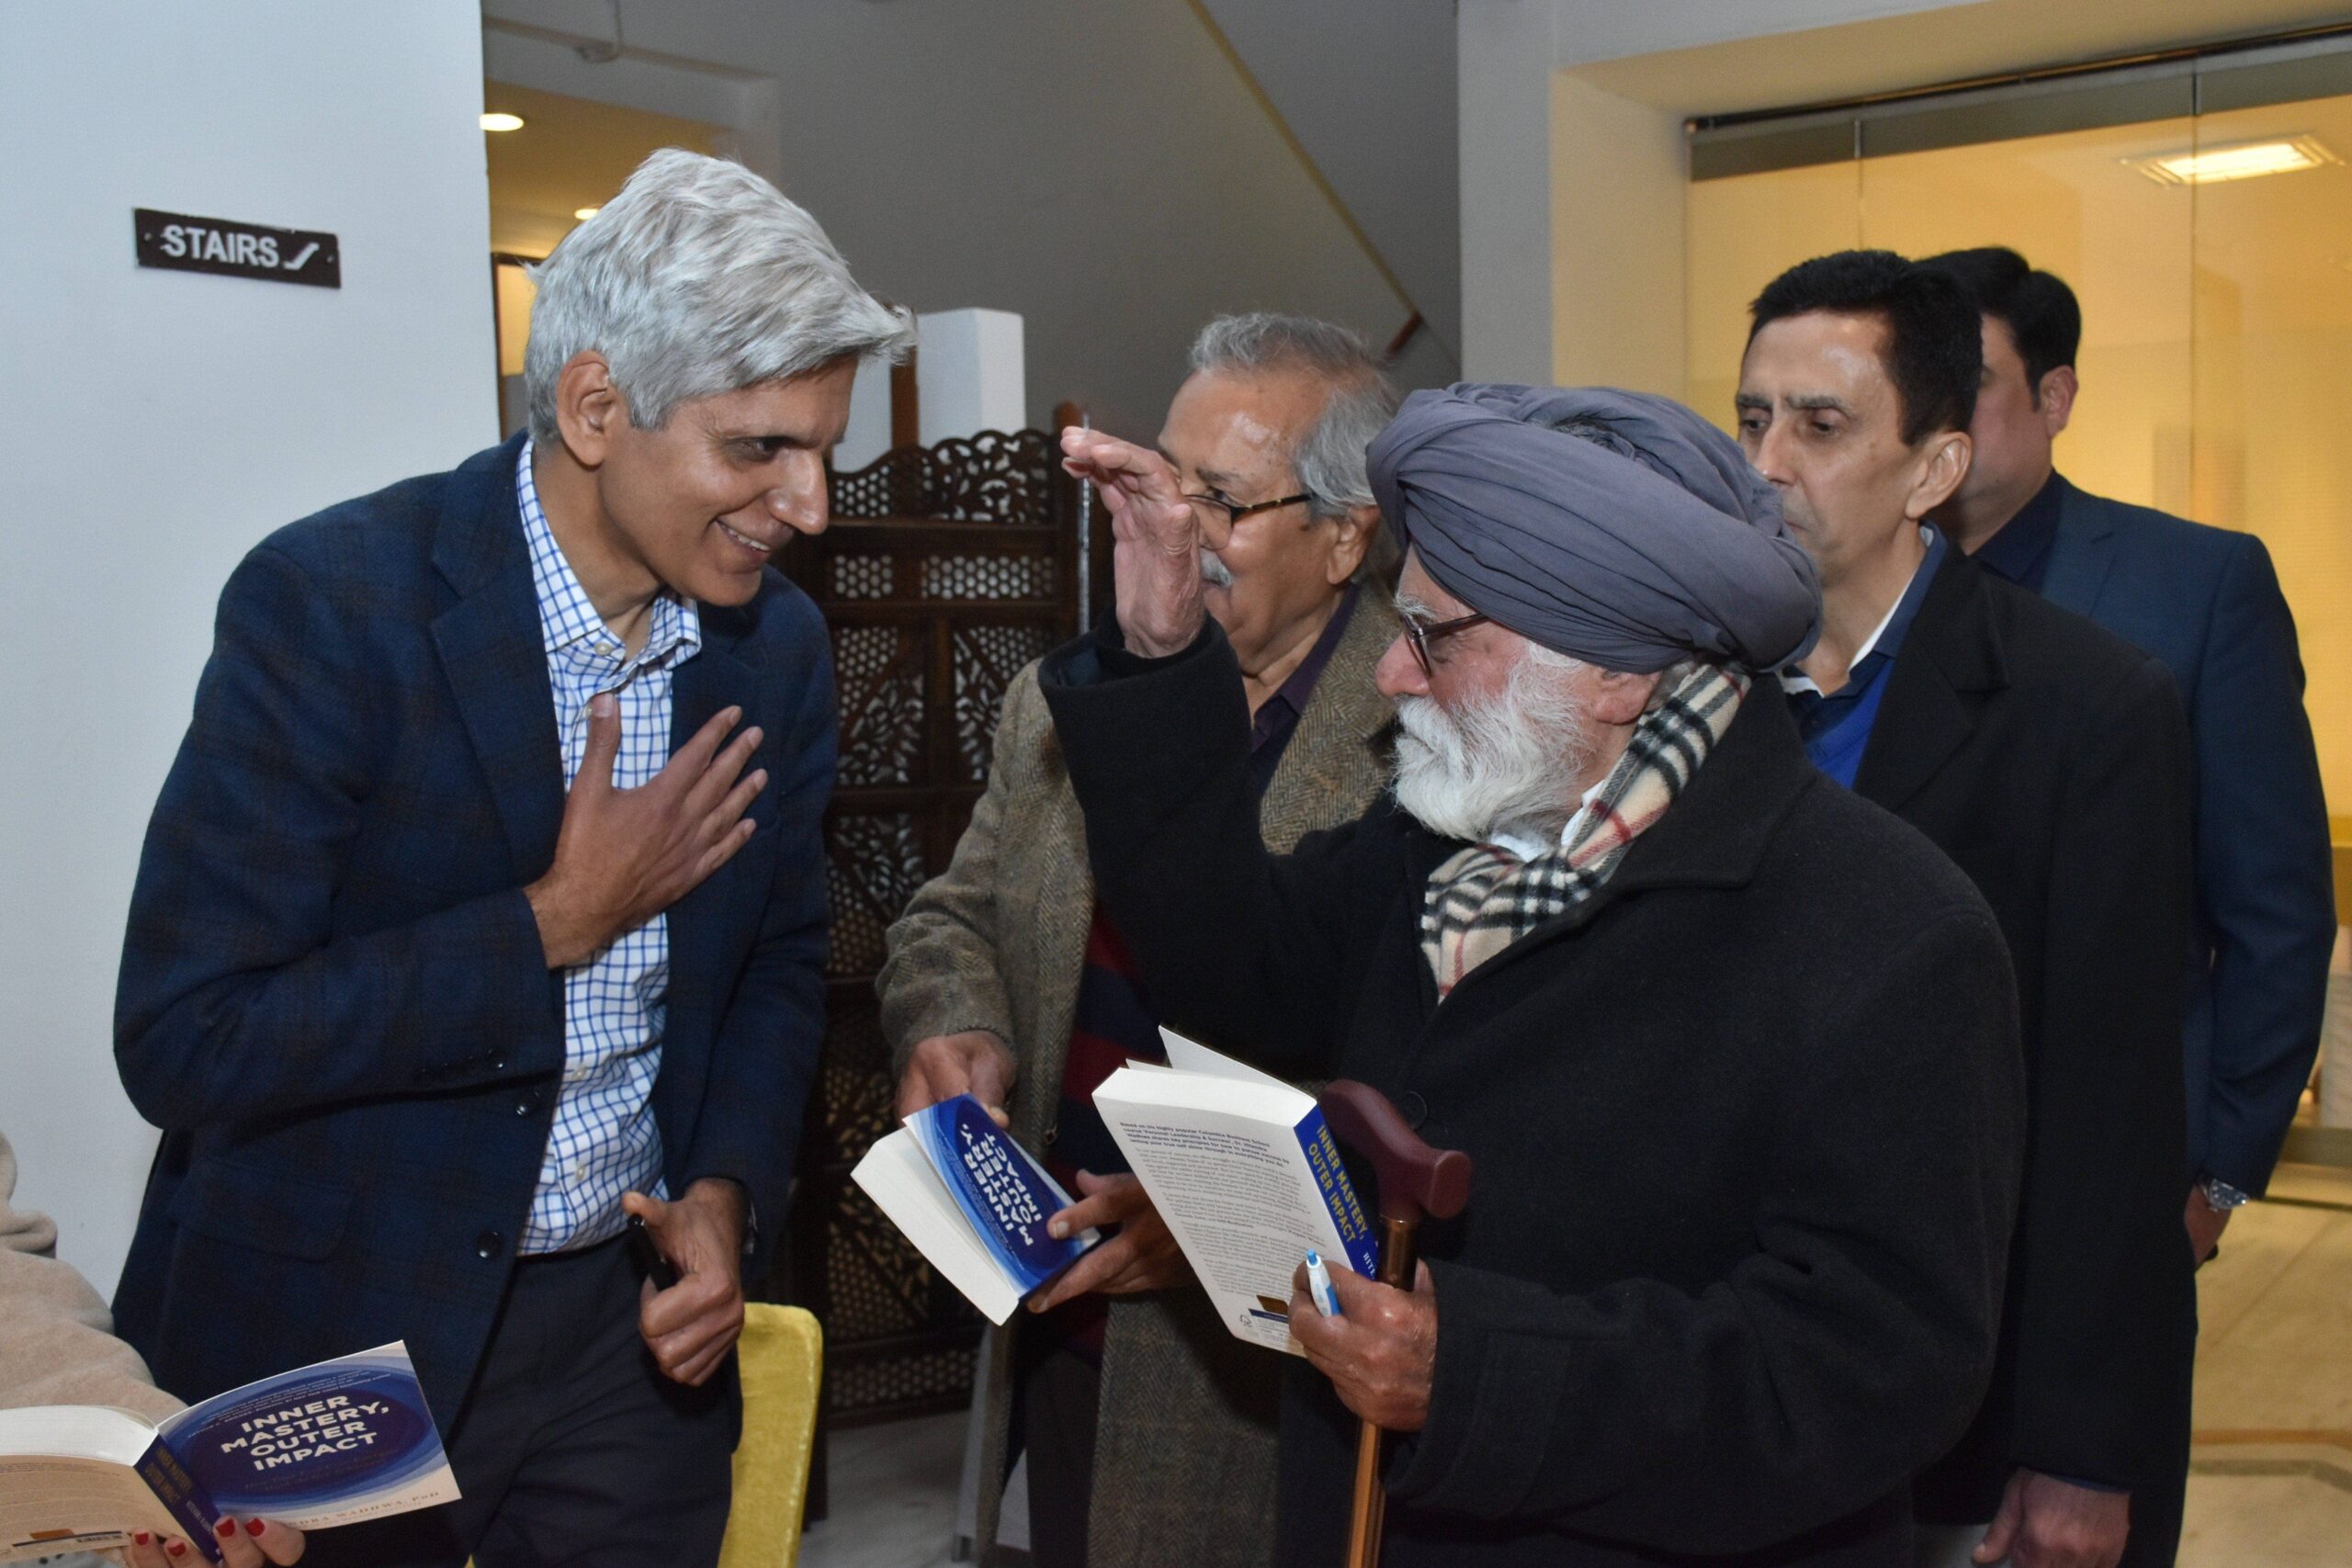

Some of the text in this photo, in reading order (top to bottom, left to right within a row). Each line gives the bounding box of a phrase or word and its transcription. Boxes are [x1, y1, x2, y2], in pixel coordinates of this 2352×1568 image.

[160, 224, 279, 268] STAIRS
[960, 1123, 1034, 1247] MASTERY,
[965, 1152, 1014, 1231] INNER
[979, 1139, 1032, 1224] OUTER
[984, 1132, 1042, 1222] IMPACT
[1308, 1143, 1356, 1243] OUTER IMPACT
[1317, 1124, 1368, 1241] INNER MASTERY,
[220, 1401, 390, 1454] MASTERY,
[241, 1395, 351, 1433] INNER
[250, 1422, 367, 1456] OUTER
[254, 1433, 379, 1471] IMPACT
